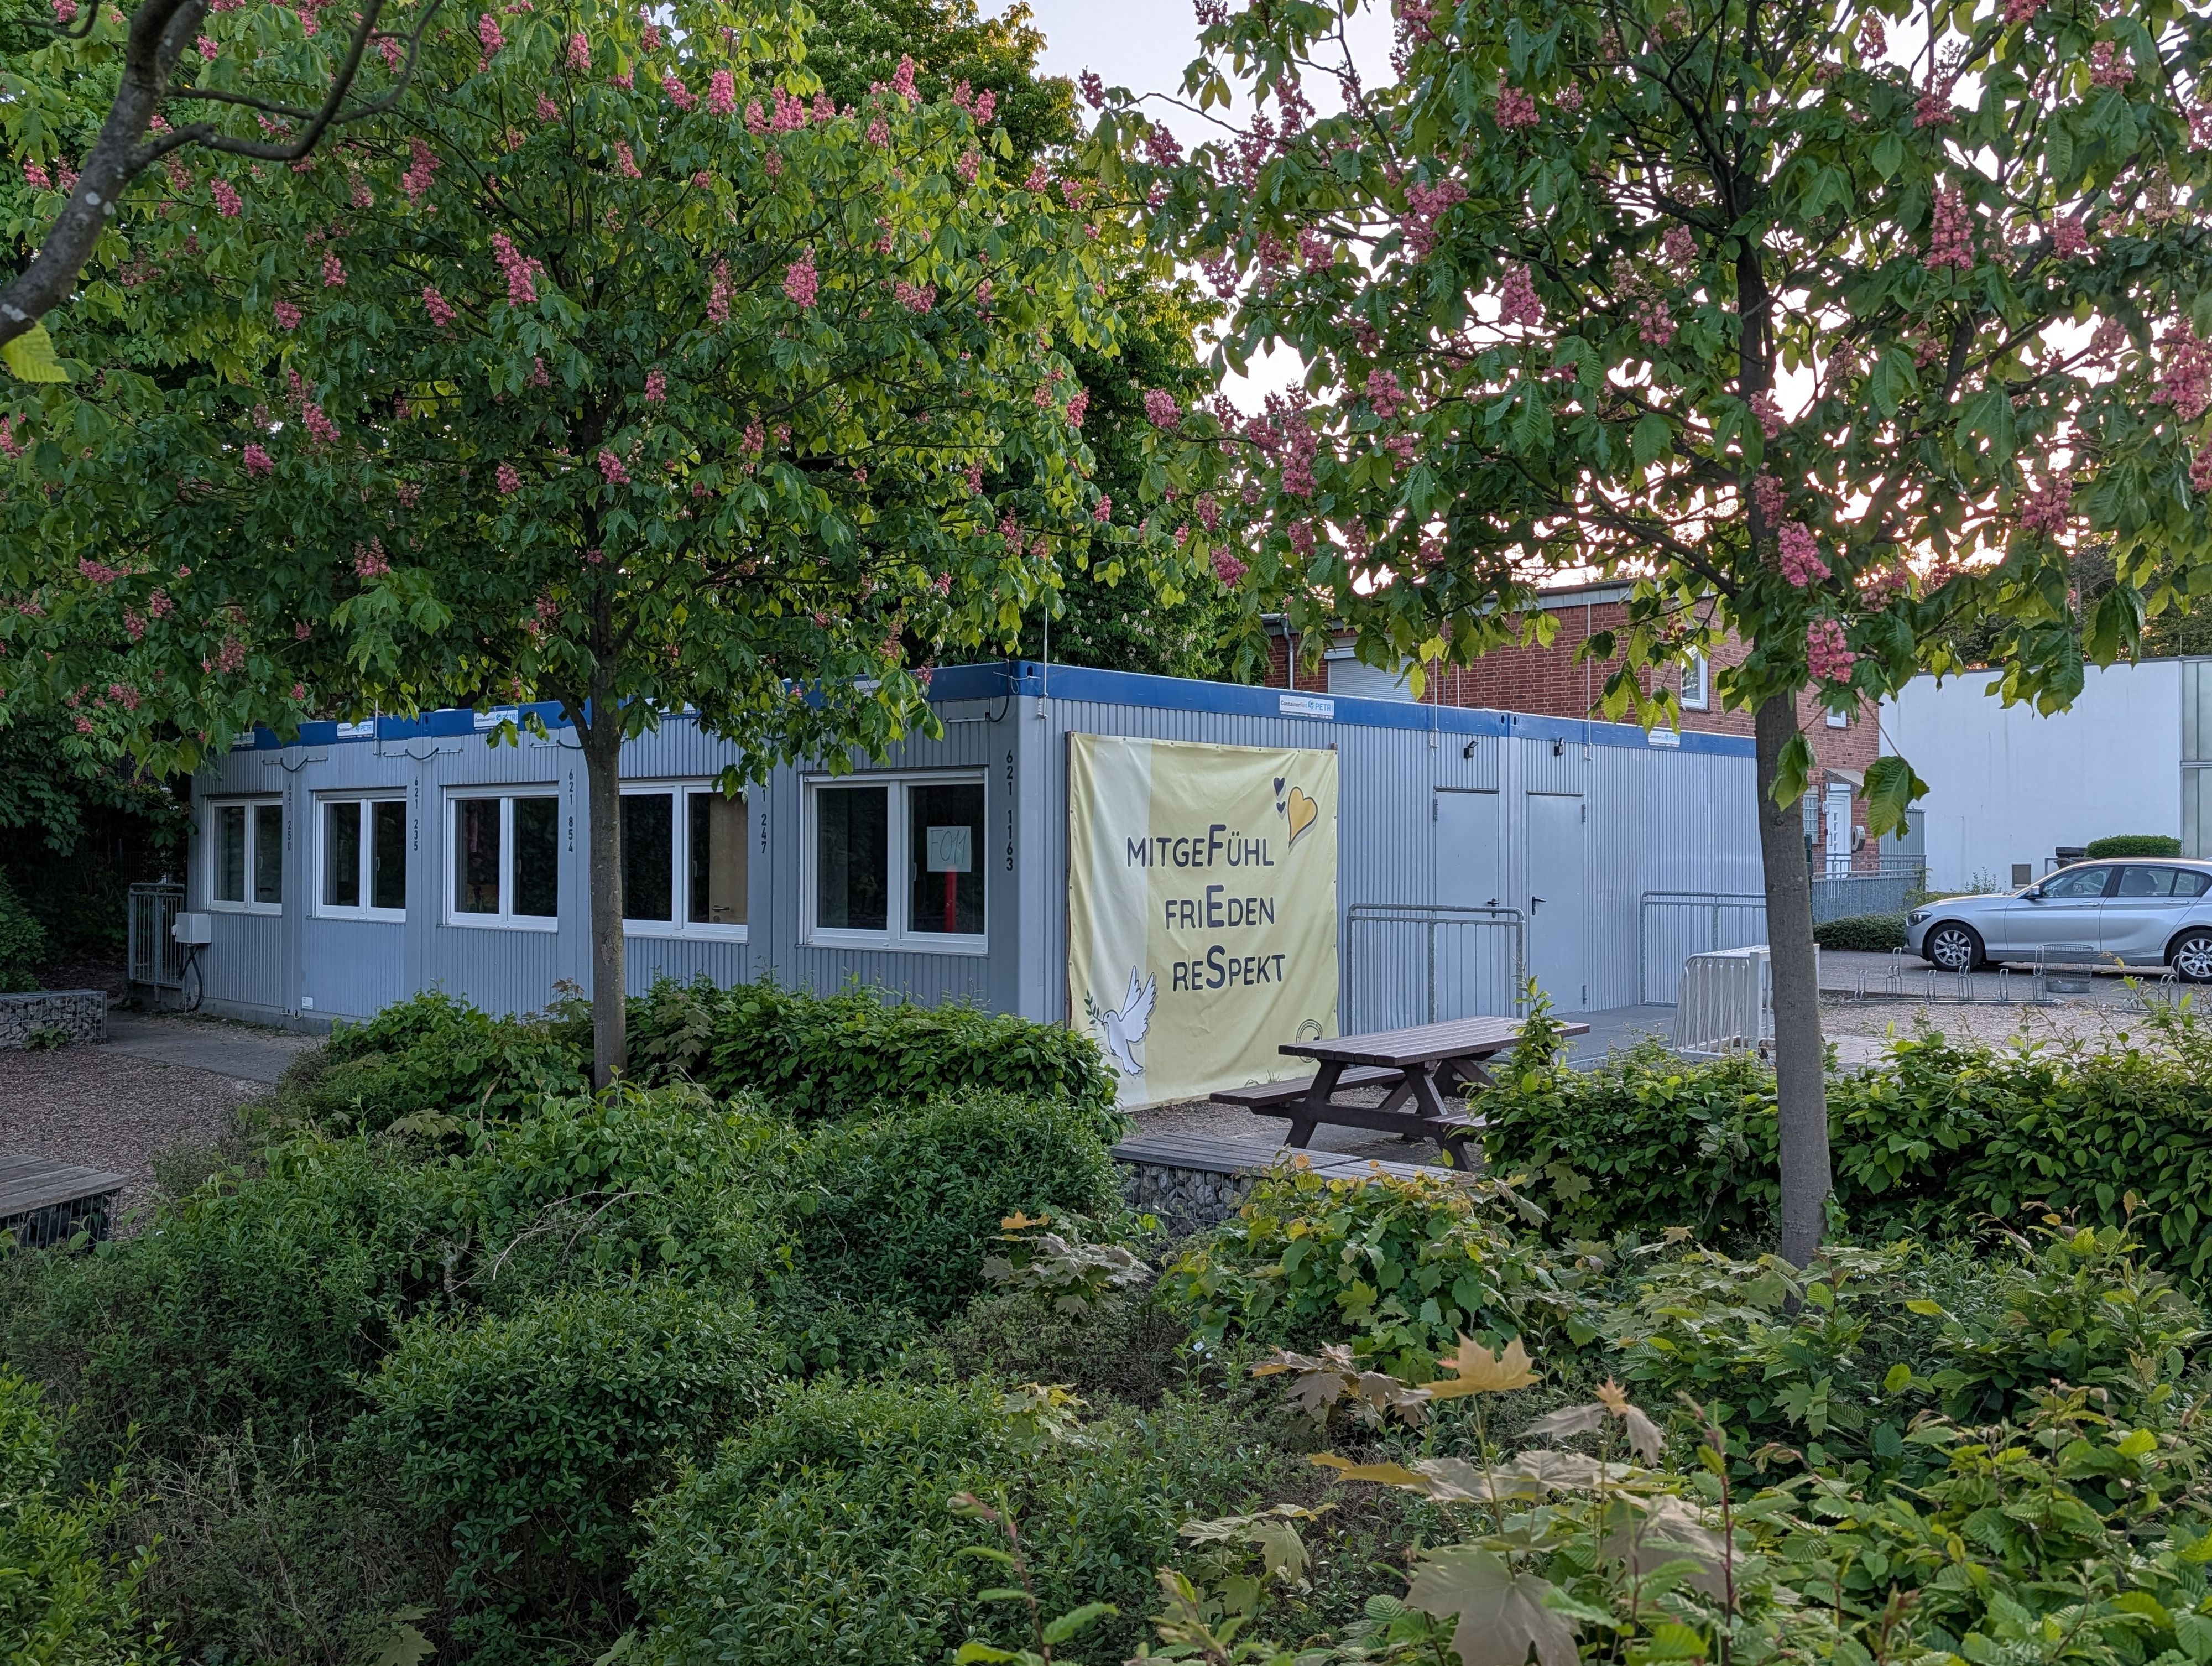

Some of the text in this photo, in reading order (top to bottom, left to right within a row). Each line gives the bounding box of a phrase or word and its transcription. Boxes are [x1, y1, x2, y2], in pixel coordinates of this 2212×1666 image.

[1315, 702, 1333, 712] PETRI
[1165, 885, 1275, 930] FRIEDEN
[1172, 945, 1286, 992] RESPEKT
